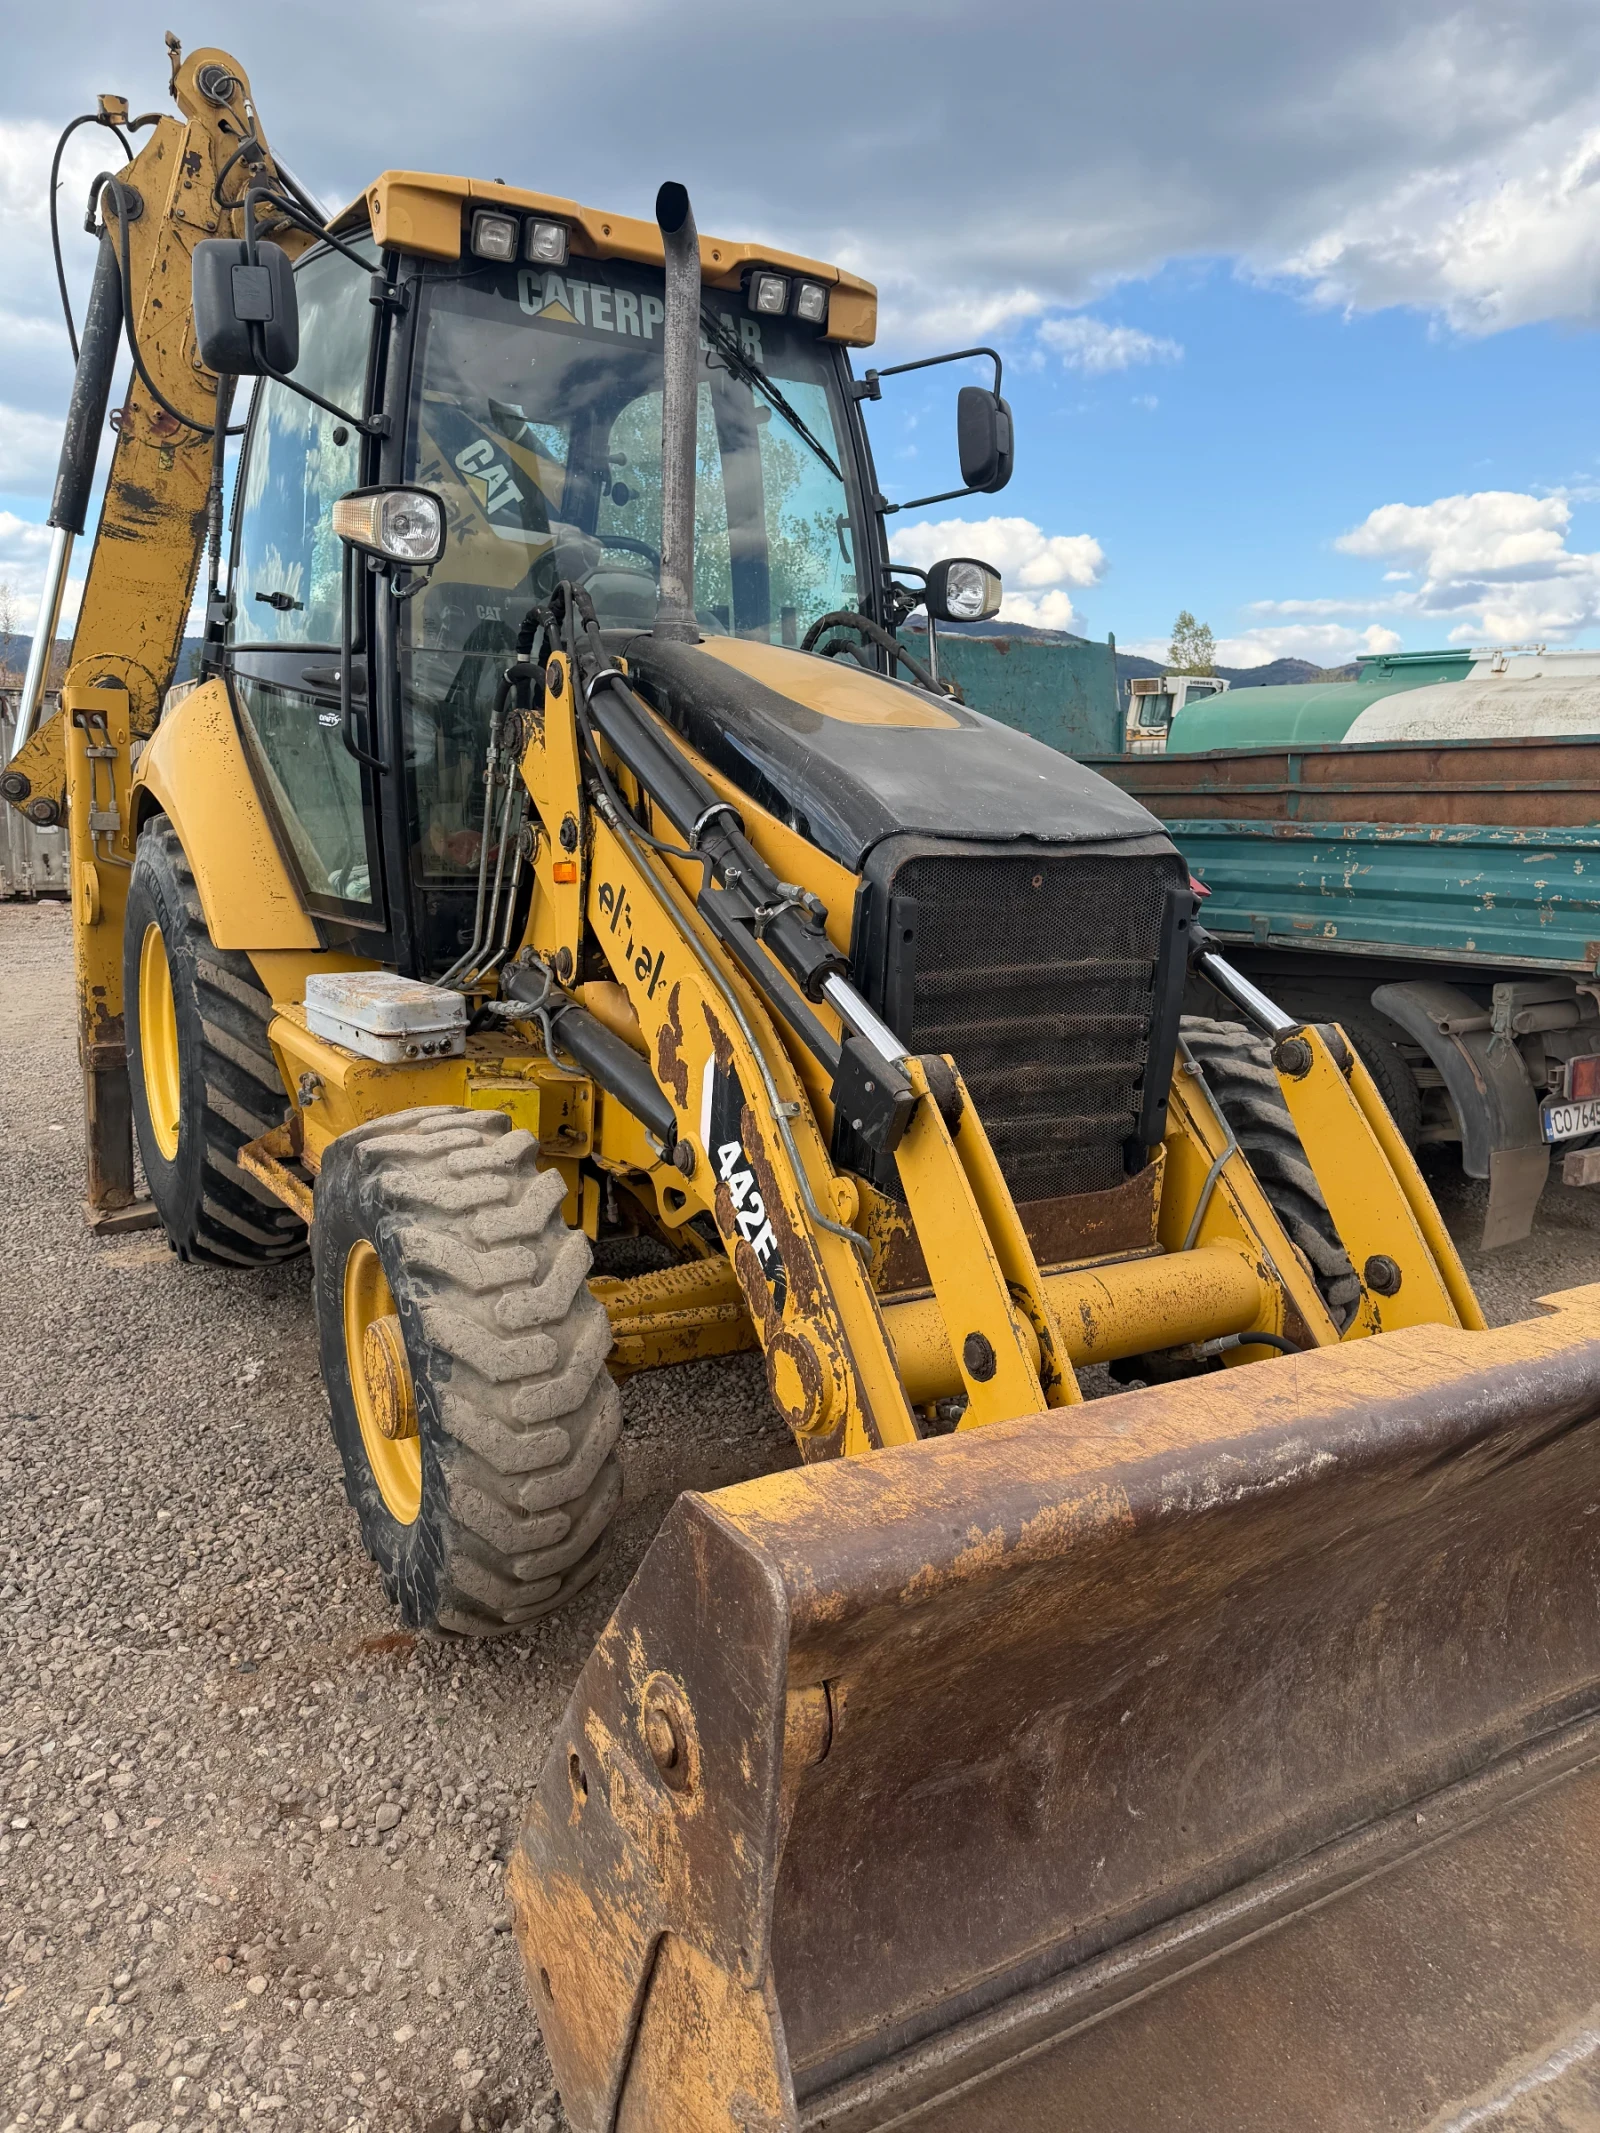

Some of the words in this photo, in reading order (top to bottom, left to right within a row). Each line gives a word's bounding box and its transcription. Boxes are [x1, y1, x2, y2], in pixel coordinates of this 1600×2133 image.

[455, 439, 524, 515] CAT
[476, 604, 501, 621] CAT
[717, 1140, 778, 1270] 442E
